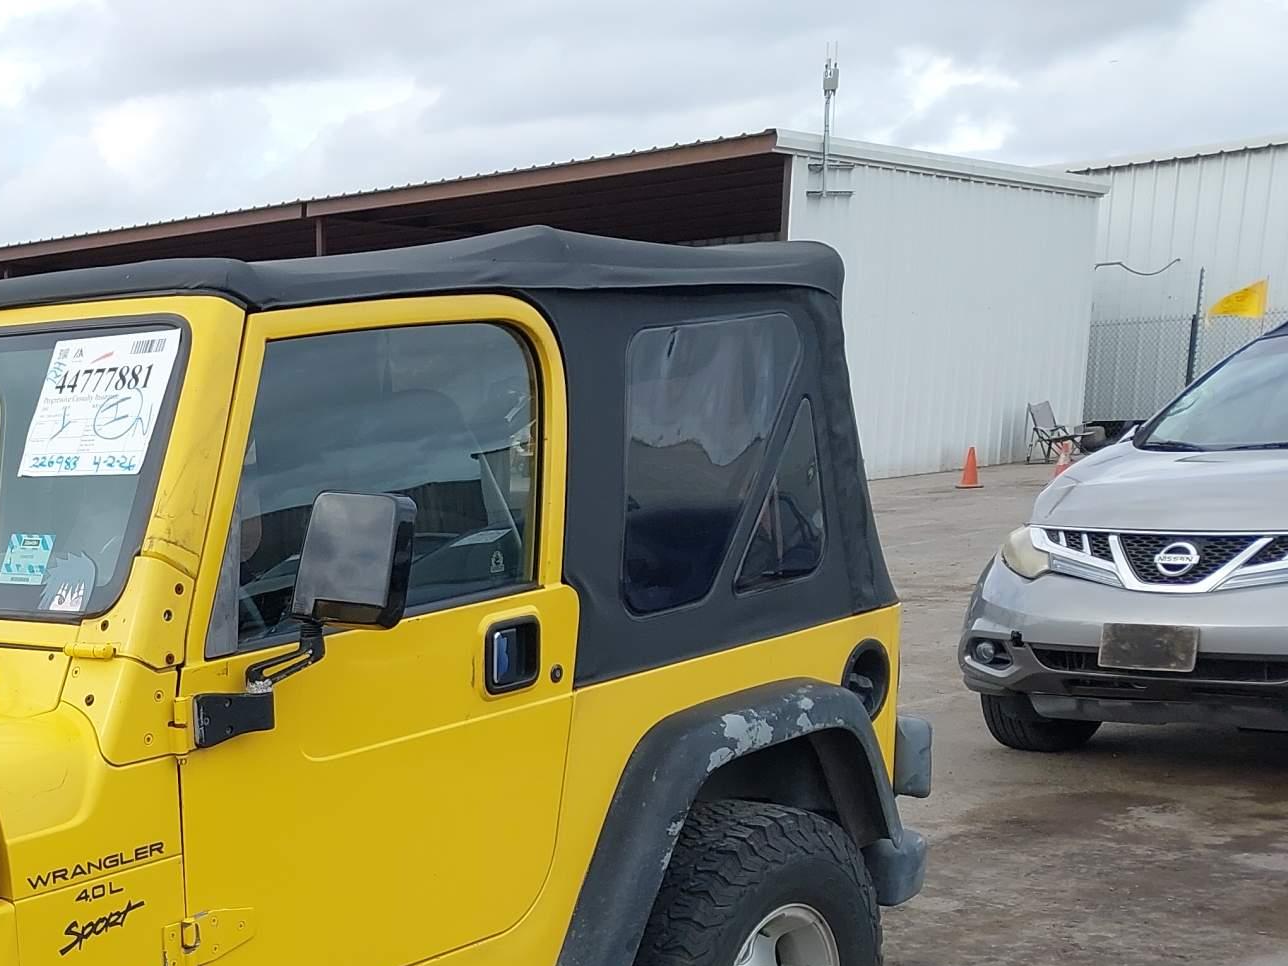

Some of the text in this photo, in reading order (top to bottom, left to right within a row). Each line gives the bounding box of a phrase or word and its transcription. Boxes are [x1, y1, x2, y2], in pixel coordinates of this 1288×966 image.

[55, 363, 154, 394] 44777881
[27, 841, 164, 890] WRANGLER
[59, 899, 145, 956] Sport
